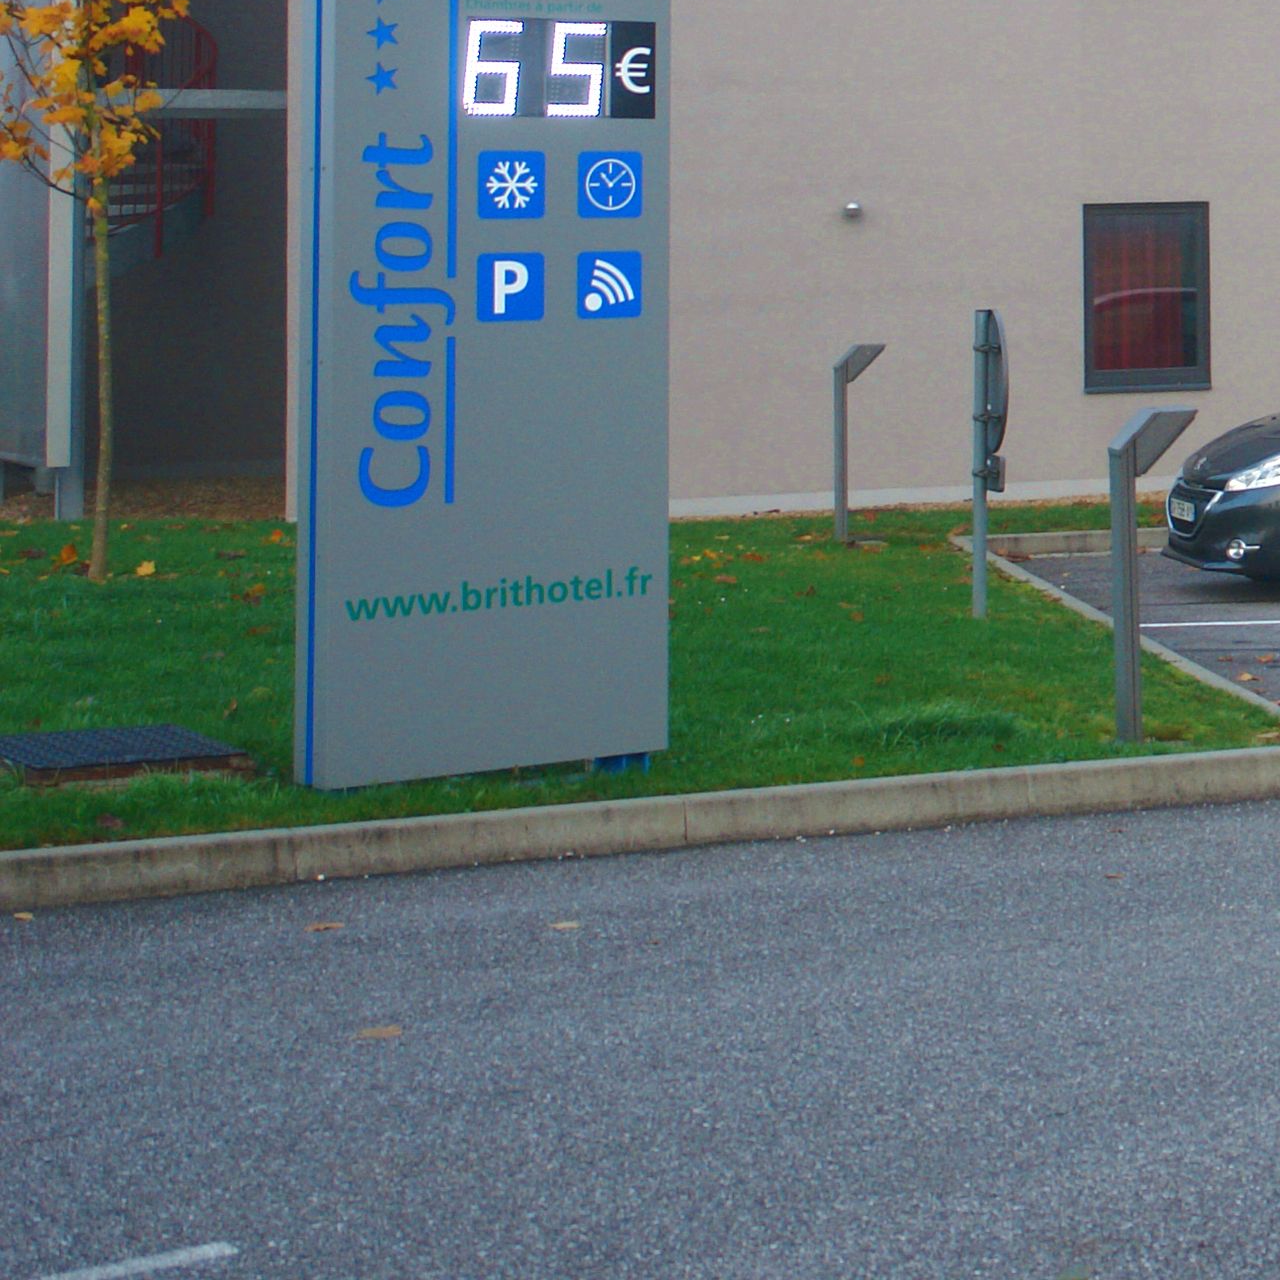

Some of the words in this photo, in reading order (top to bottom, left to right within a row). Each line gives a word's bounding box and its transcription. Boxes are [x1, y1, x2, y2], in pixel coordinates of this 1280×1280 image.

[492, 259, 529, 314] P
[349, 131, 457, 508] Confort
[345, 566, 653, 621] www.brithotel.fr
